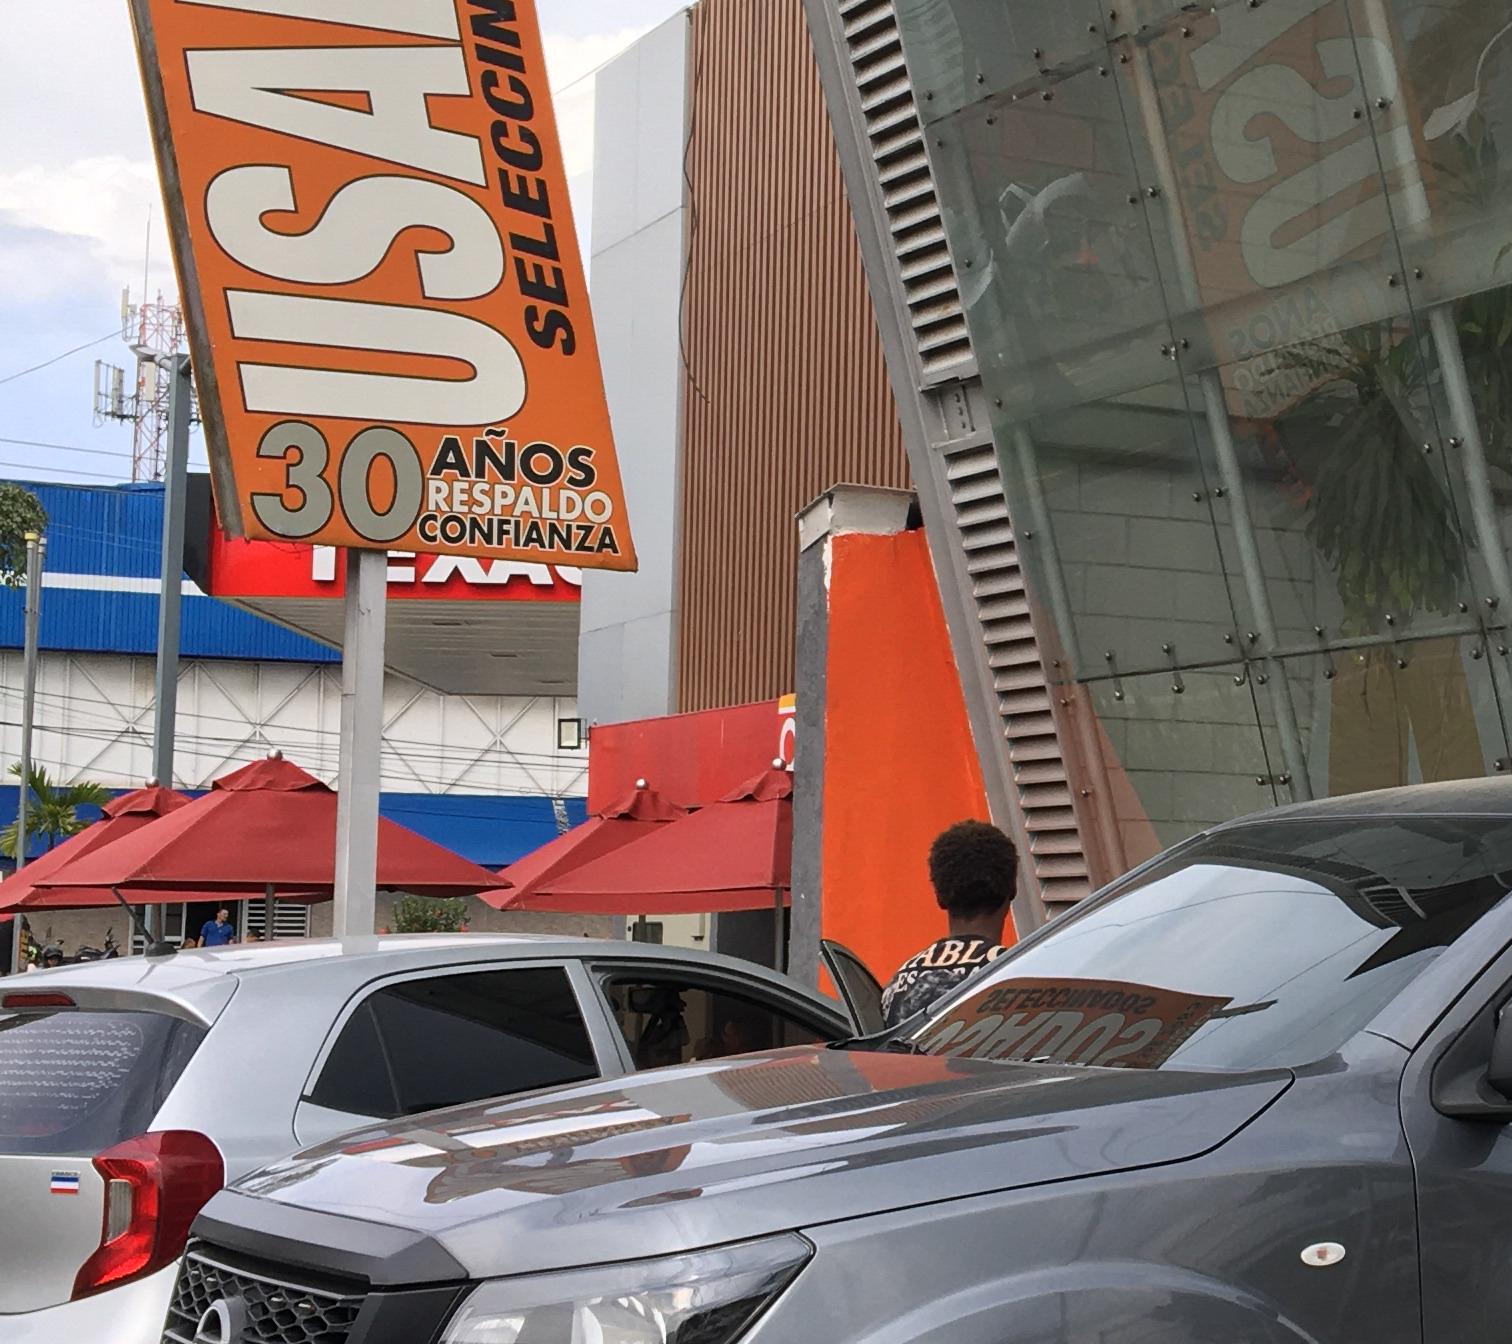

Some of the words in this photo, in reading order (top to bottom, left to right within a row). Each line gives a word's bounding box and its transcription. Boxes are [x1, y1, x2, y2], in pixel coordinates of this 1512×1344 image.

[250, 420, 424, 542] 30
[428, 427, 597, 490] AÑOS
[428, 480, 613, 524] RESPALDO
[417, 513, 621, 556] CONFIANZA
